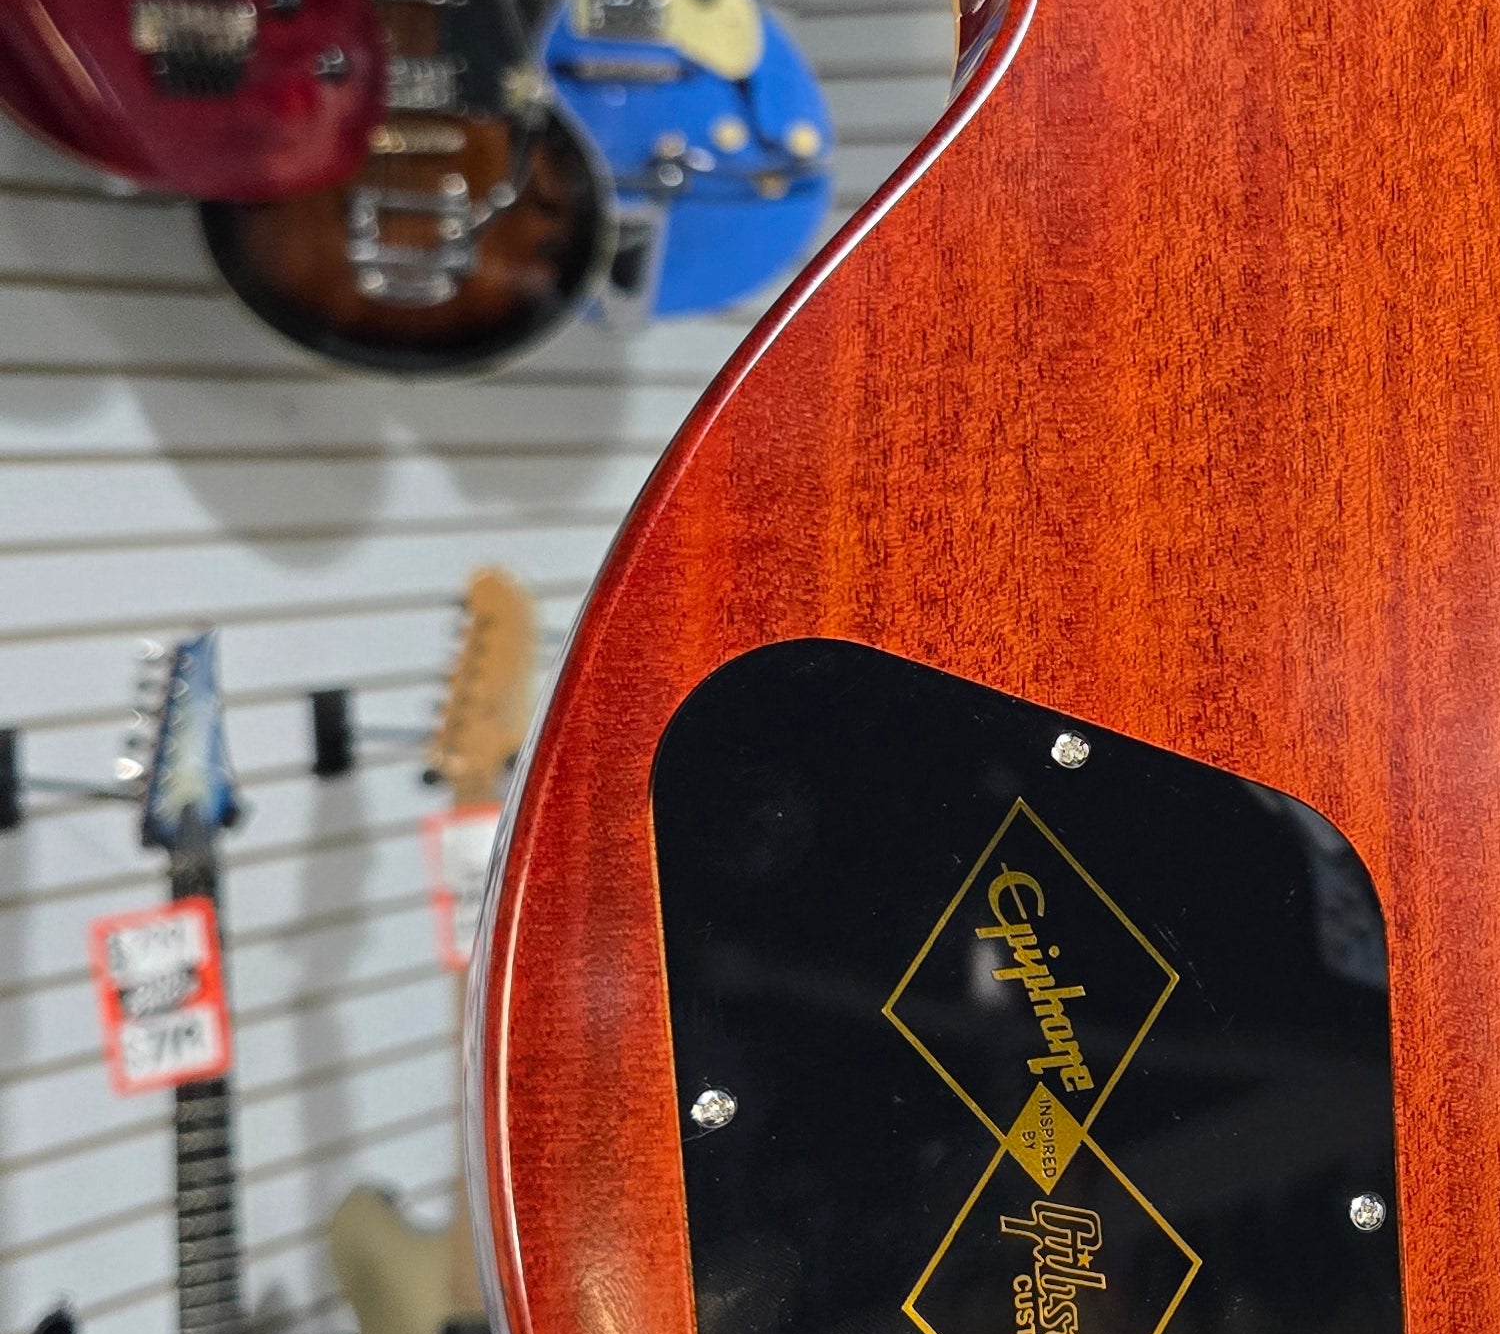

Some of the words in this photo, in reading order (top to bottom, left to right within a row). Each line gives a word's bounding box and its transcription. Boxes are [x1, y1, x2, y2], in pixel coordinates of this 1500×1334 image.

[974, 861, 1095, 1093] Epiphone
[1021, 1130, 1036, 1151] BY
[1038, 1099, 1057, 1179] INSPIRED
